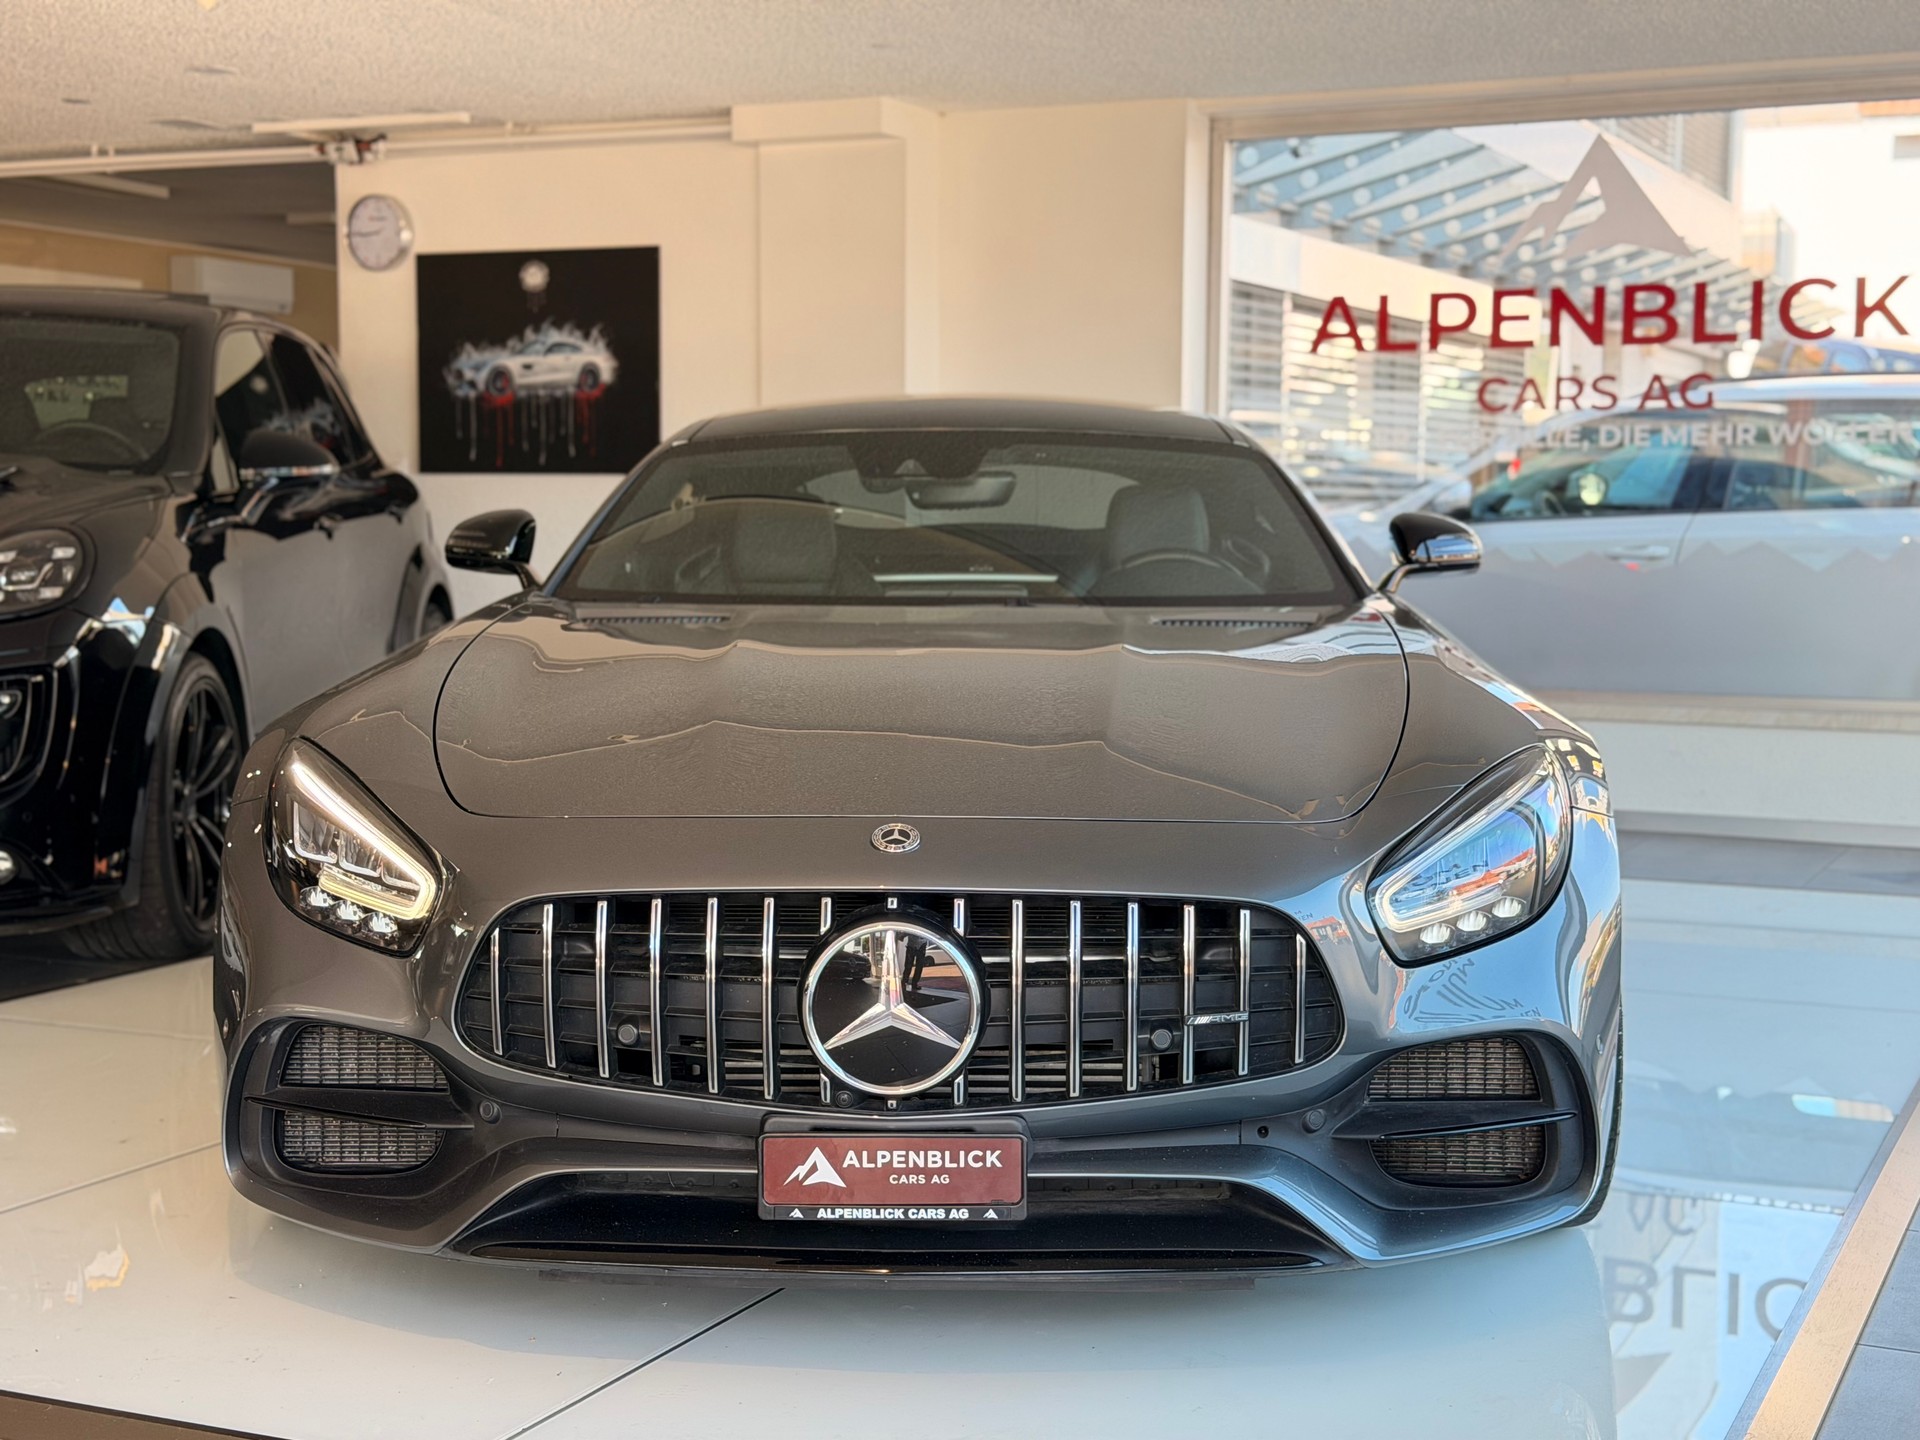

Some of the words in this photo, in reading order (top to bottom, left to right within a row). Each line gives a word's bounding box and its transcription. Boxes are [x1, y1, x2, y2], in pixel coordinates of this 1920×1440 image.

[1309, 275, 1910, 353] ALPENBLICK
[1477, 375, 1618, 412] CARS
[1637, 373, 1714, 411] AG
[1601, 424, 1650, 447] DIE
[1661, 421, 1758, 447] MEHR
[1207, 1011, 1249, 1024] AMG
[842, 1149, 1003, 1169] ALPENBLICK
[889, 1174, 926, 1185] CARS
[930, 1174, 950, 1185] AG
[816, 1207, 905, 1220] ALPENBLICK
[908, 1207, 946, 1219] CARS
[948, 1207, 969, 1220] AG
